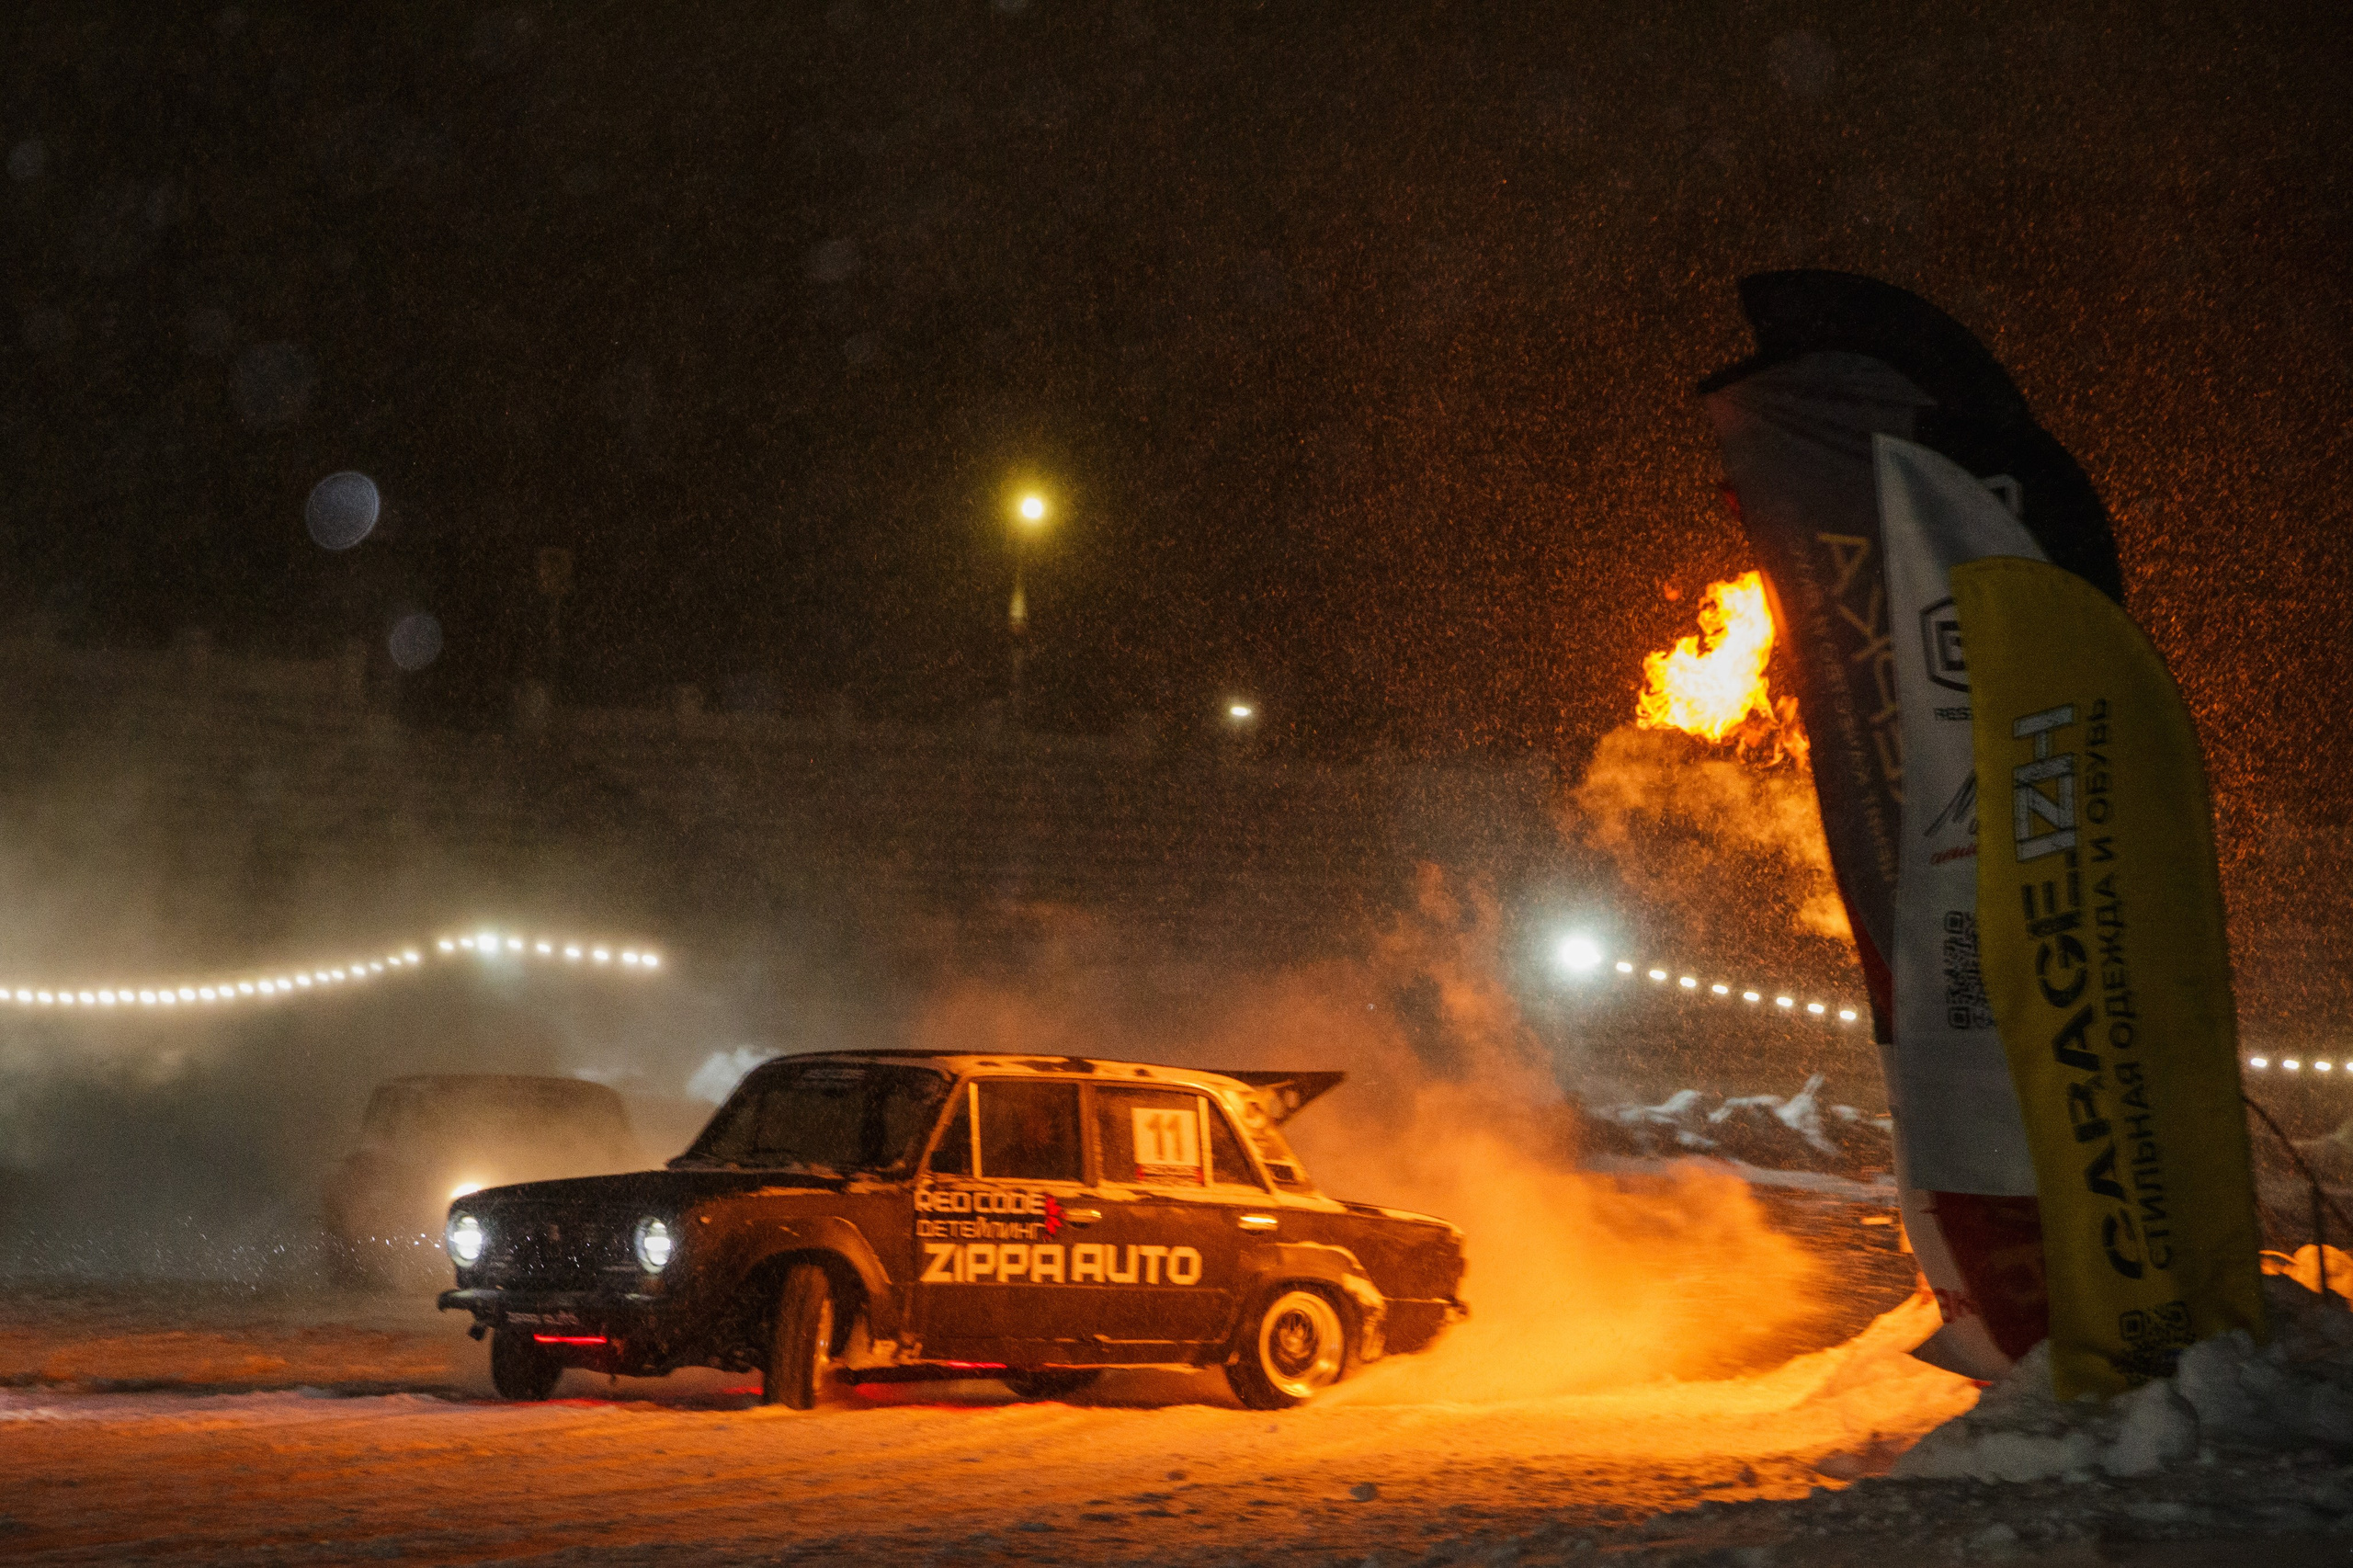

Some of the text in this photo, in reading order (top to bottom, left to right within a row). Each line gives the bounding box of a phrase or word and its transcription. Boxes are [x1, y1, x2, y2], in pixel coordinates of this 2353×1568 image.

[2085, 698, 2173, 1270] СТИЛЬНАЯ ОДЕЖДА И ОБУВЬ
[1146, 1113, 1183, 1162] 11
[915, 1190, 1046, 1214] RED CODE
[916, 1216, 1046, 1239] ДЕТЕЙЛИНГ
[920, 1243, 1203, 1286] ZIPPA AUTO
